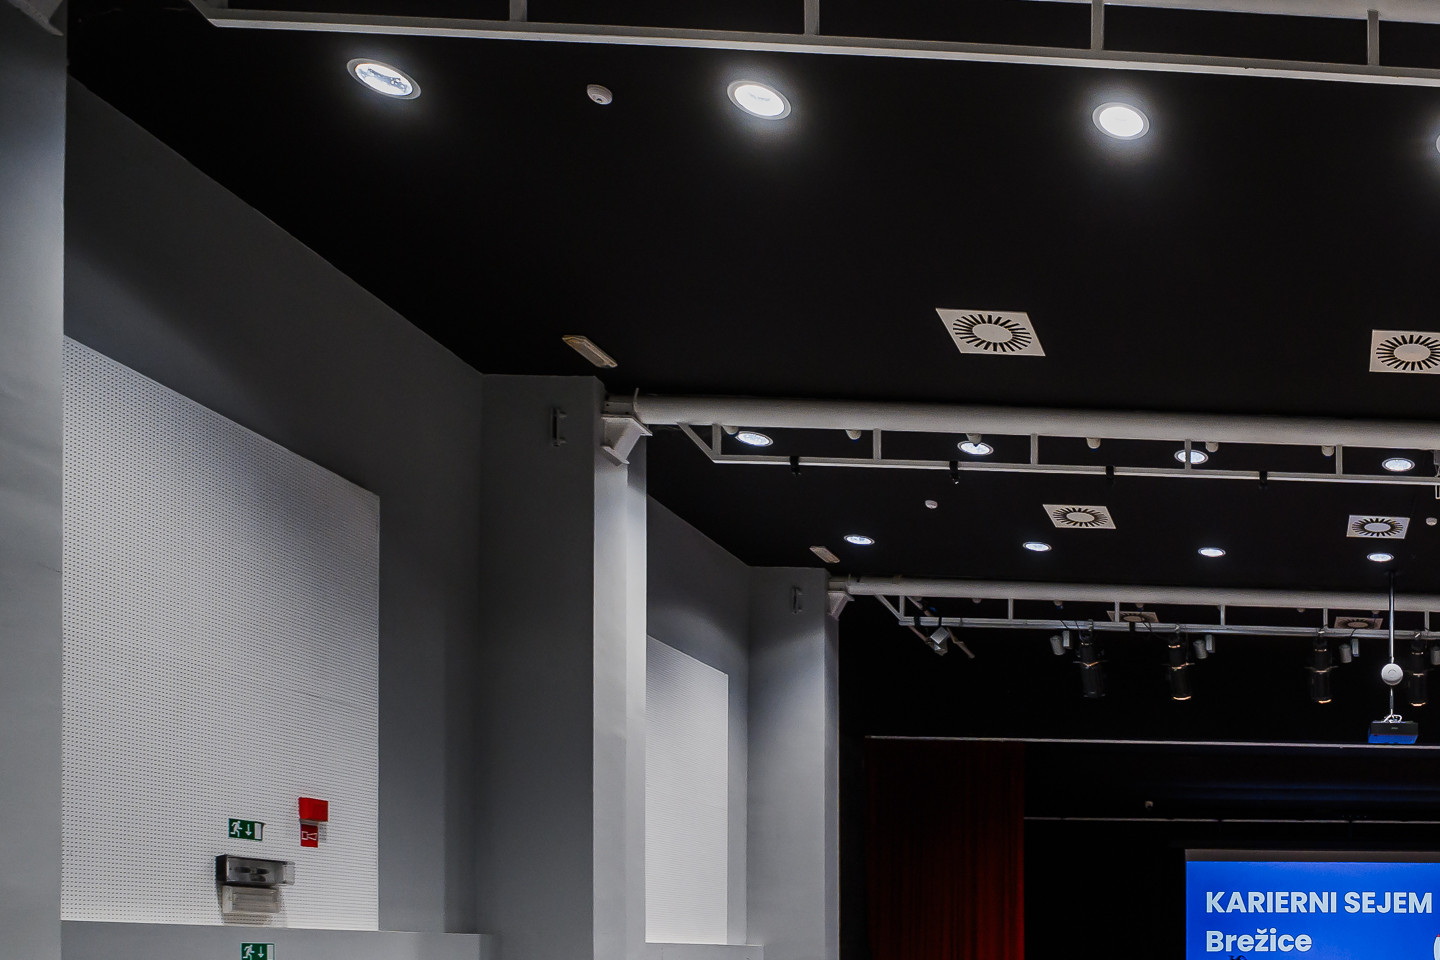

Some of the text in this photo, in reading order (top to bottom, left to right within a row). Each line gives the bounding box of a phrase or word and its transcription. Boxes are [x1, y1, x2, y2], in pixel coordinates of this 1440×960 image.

[1206, 891, 1433, 914] KARIERNI SEJEM
[1206, 927, 1313, 952] Brežice
